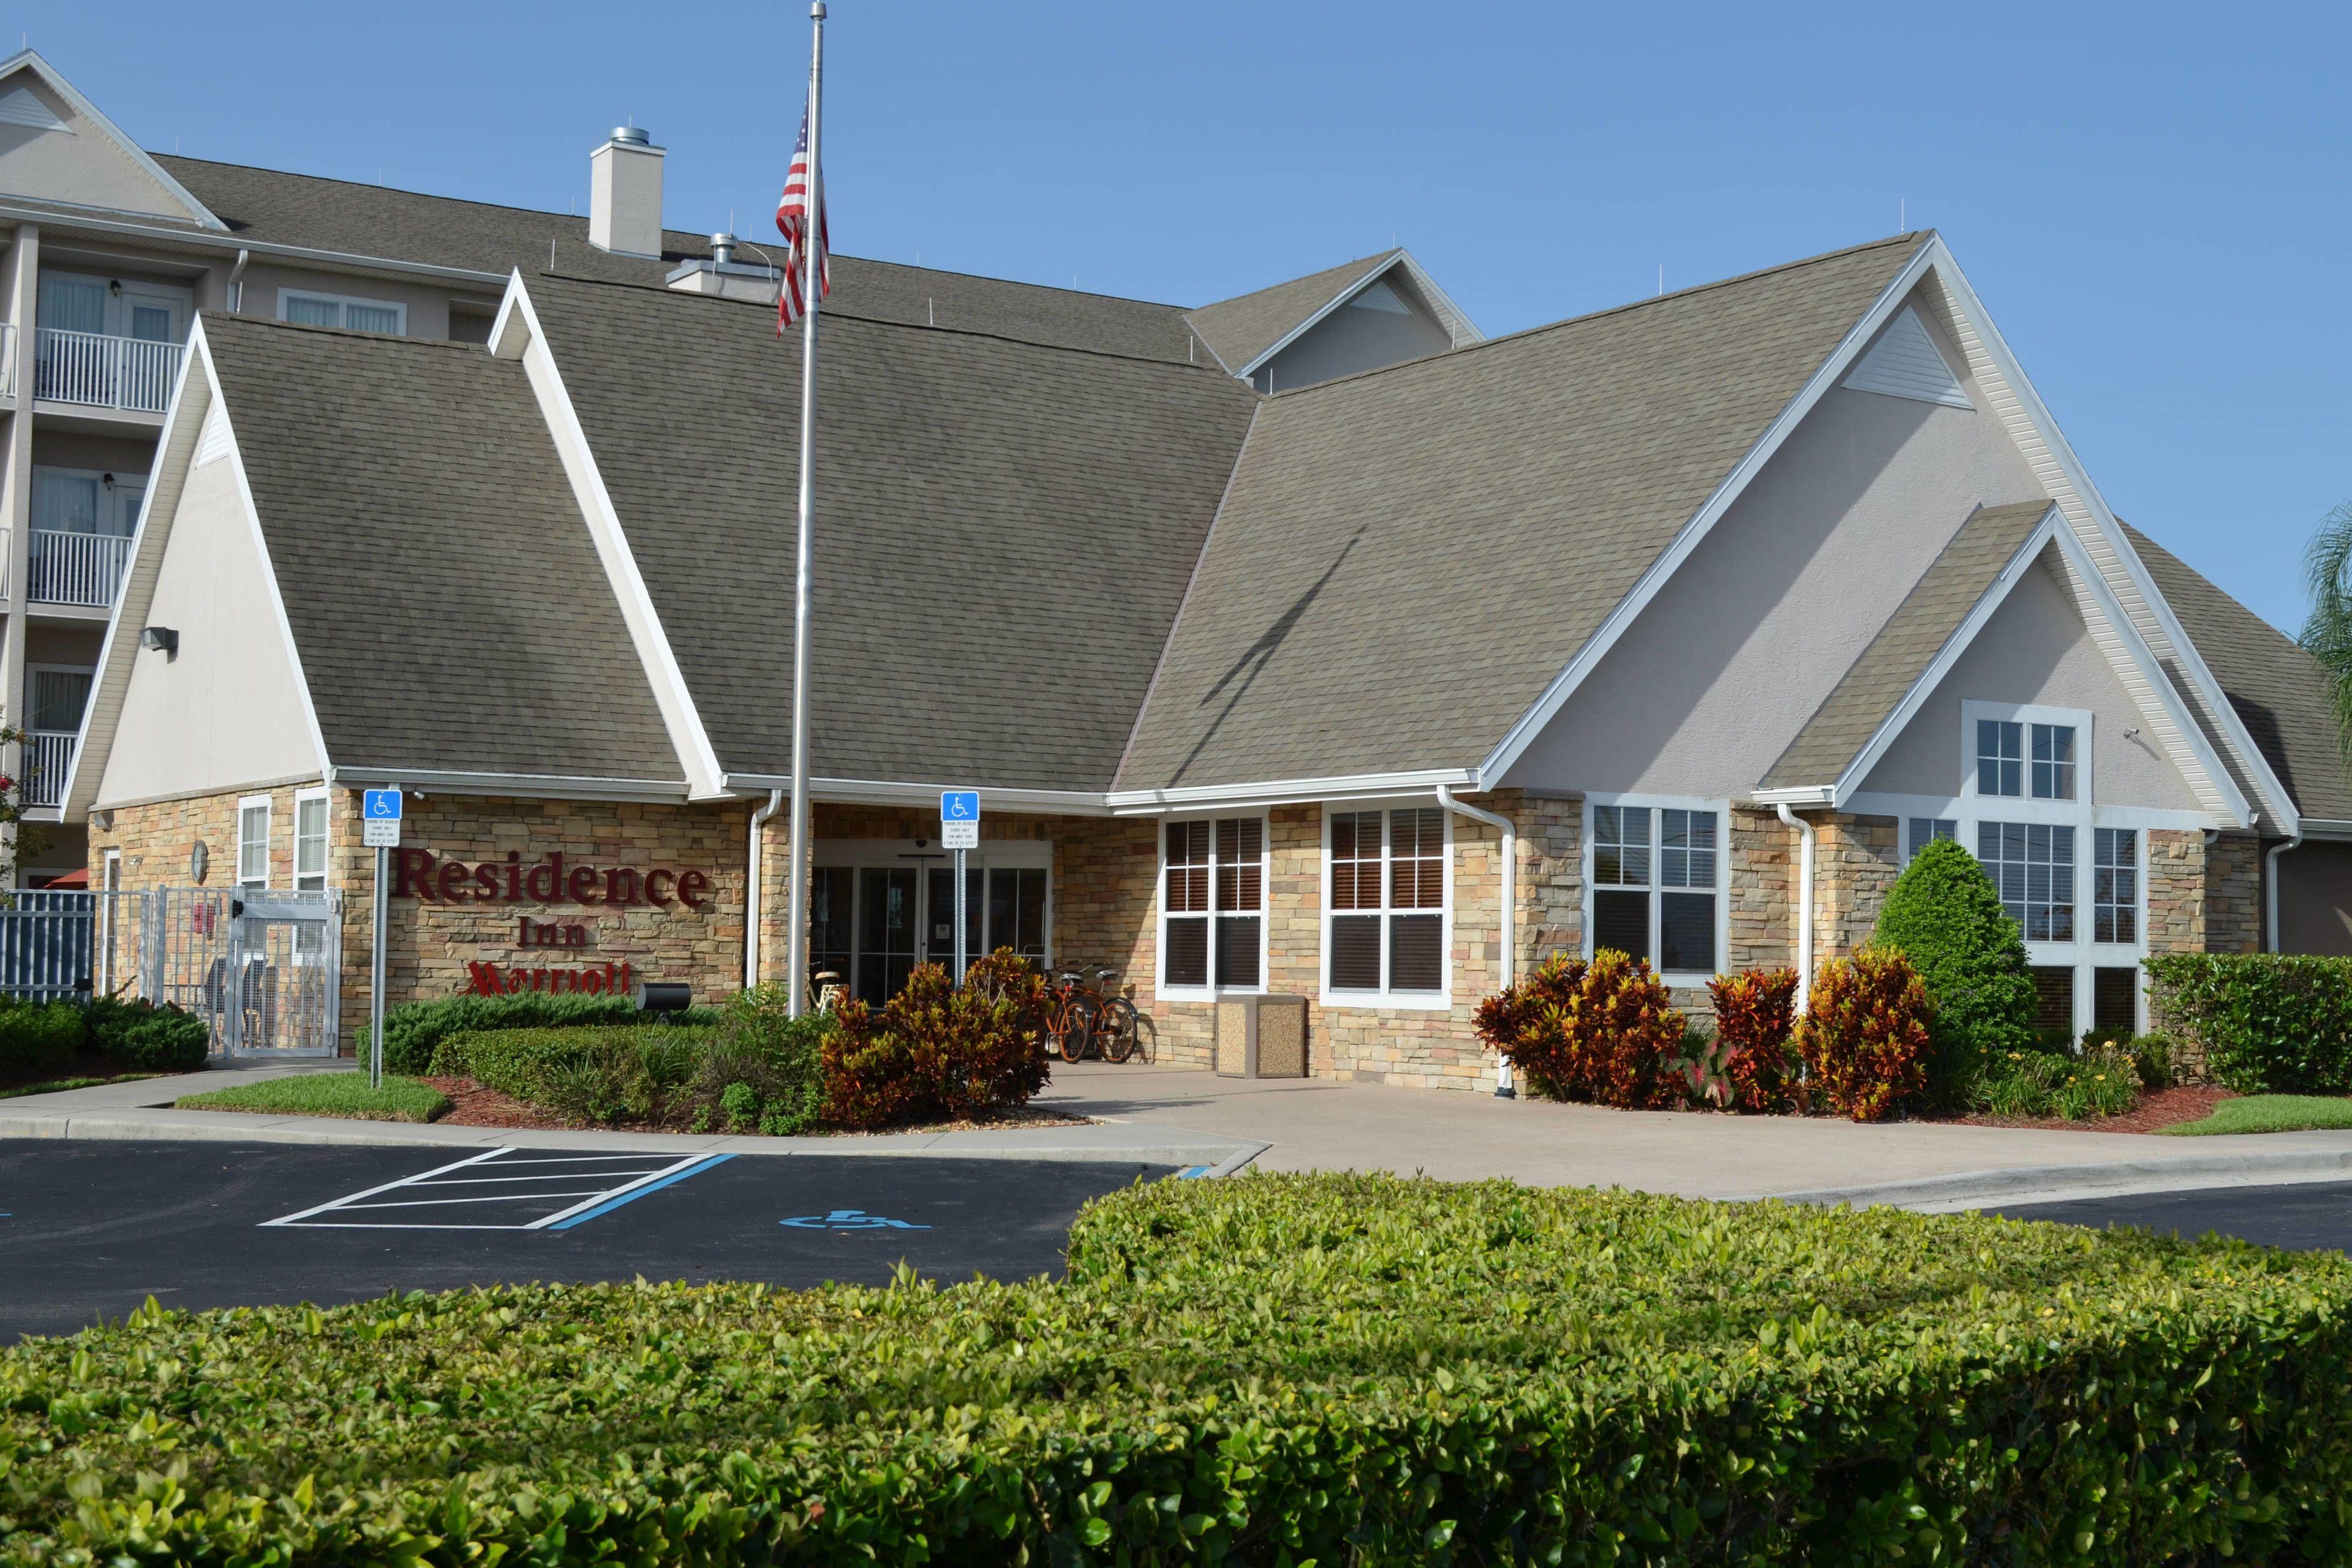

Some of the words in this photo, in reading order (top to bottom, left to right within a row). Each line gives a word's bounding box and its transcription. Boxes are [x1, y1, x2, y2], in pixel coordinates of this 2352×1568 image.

[390, 848, 706, 906] Residence
[517, 916, 586, 947] Inn
[457, 960, 630, 997] Marriott
